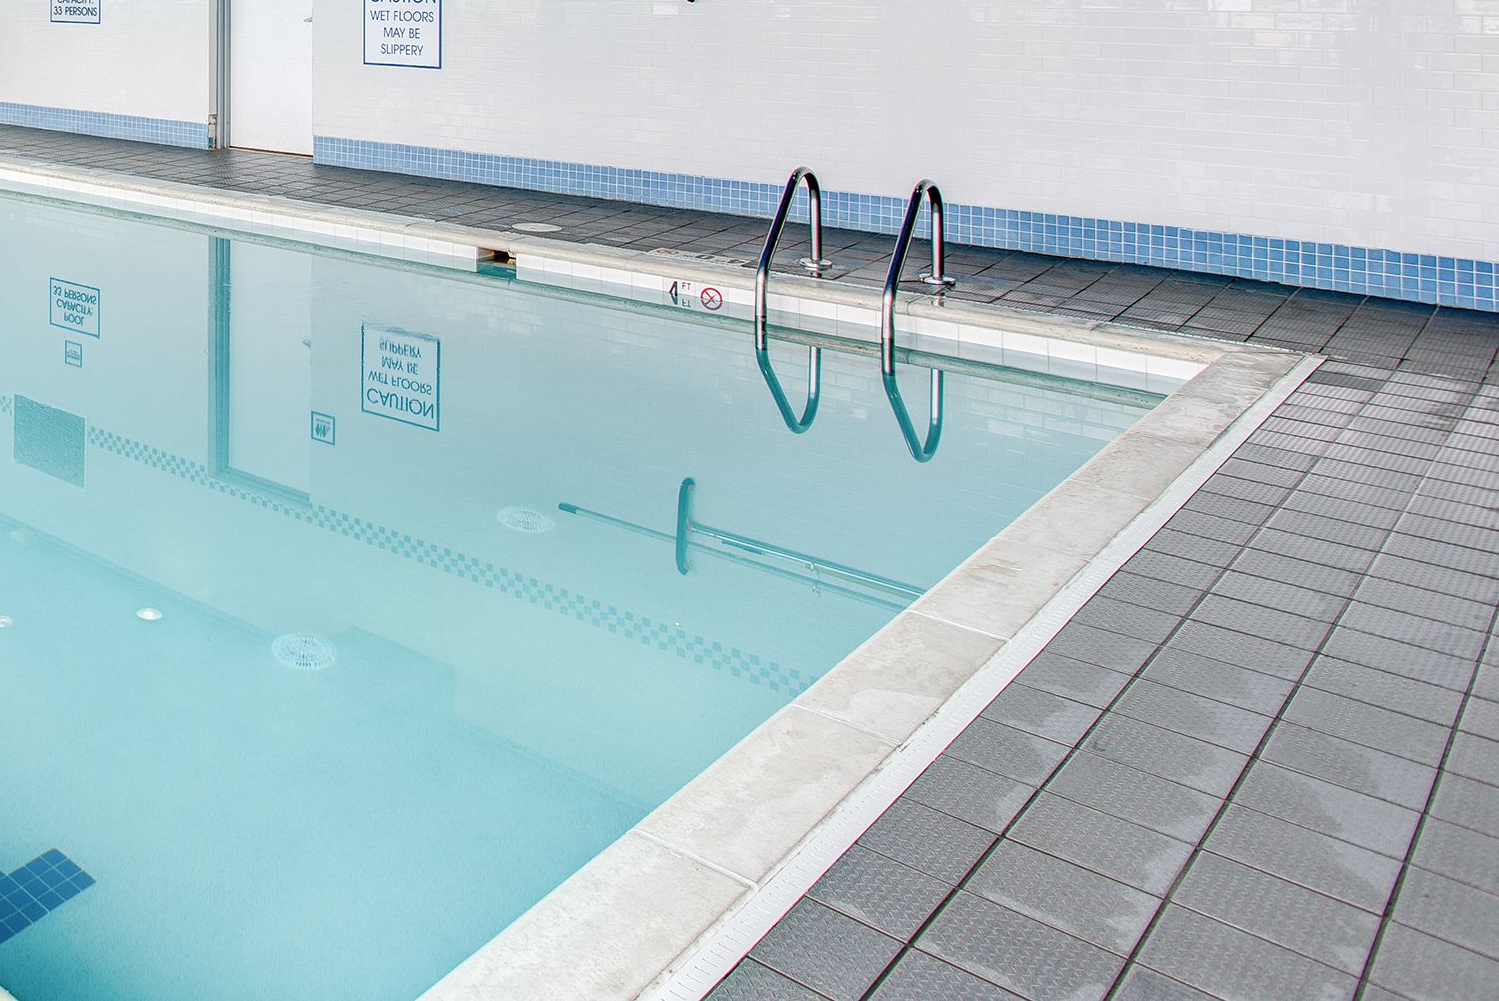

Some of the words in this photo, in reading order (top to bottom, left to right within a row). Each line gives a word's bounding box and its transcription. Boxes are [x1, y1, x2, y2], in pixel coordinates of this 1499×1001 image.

[53, 5, 62, 15] 33
[65, 6, 97, 17] PERSONS
[370, 10, 390, 21] WET
[393, 10, 435, 23] FLOORS
[383, 27, 405, 38] MAY
[409, 28, 420, 39] BE
[380, 43, 424, 55] SLIPPERY
[681, 282, 692, 291] FT
